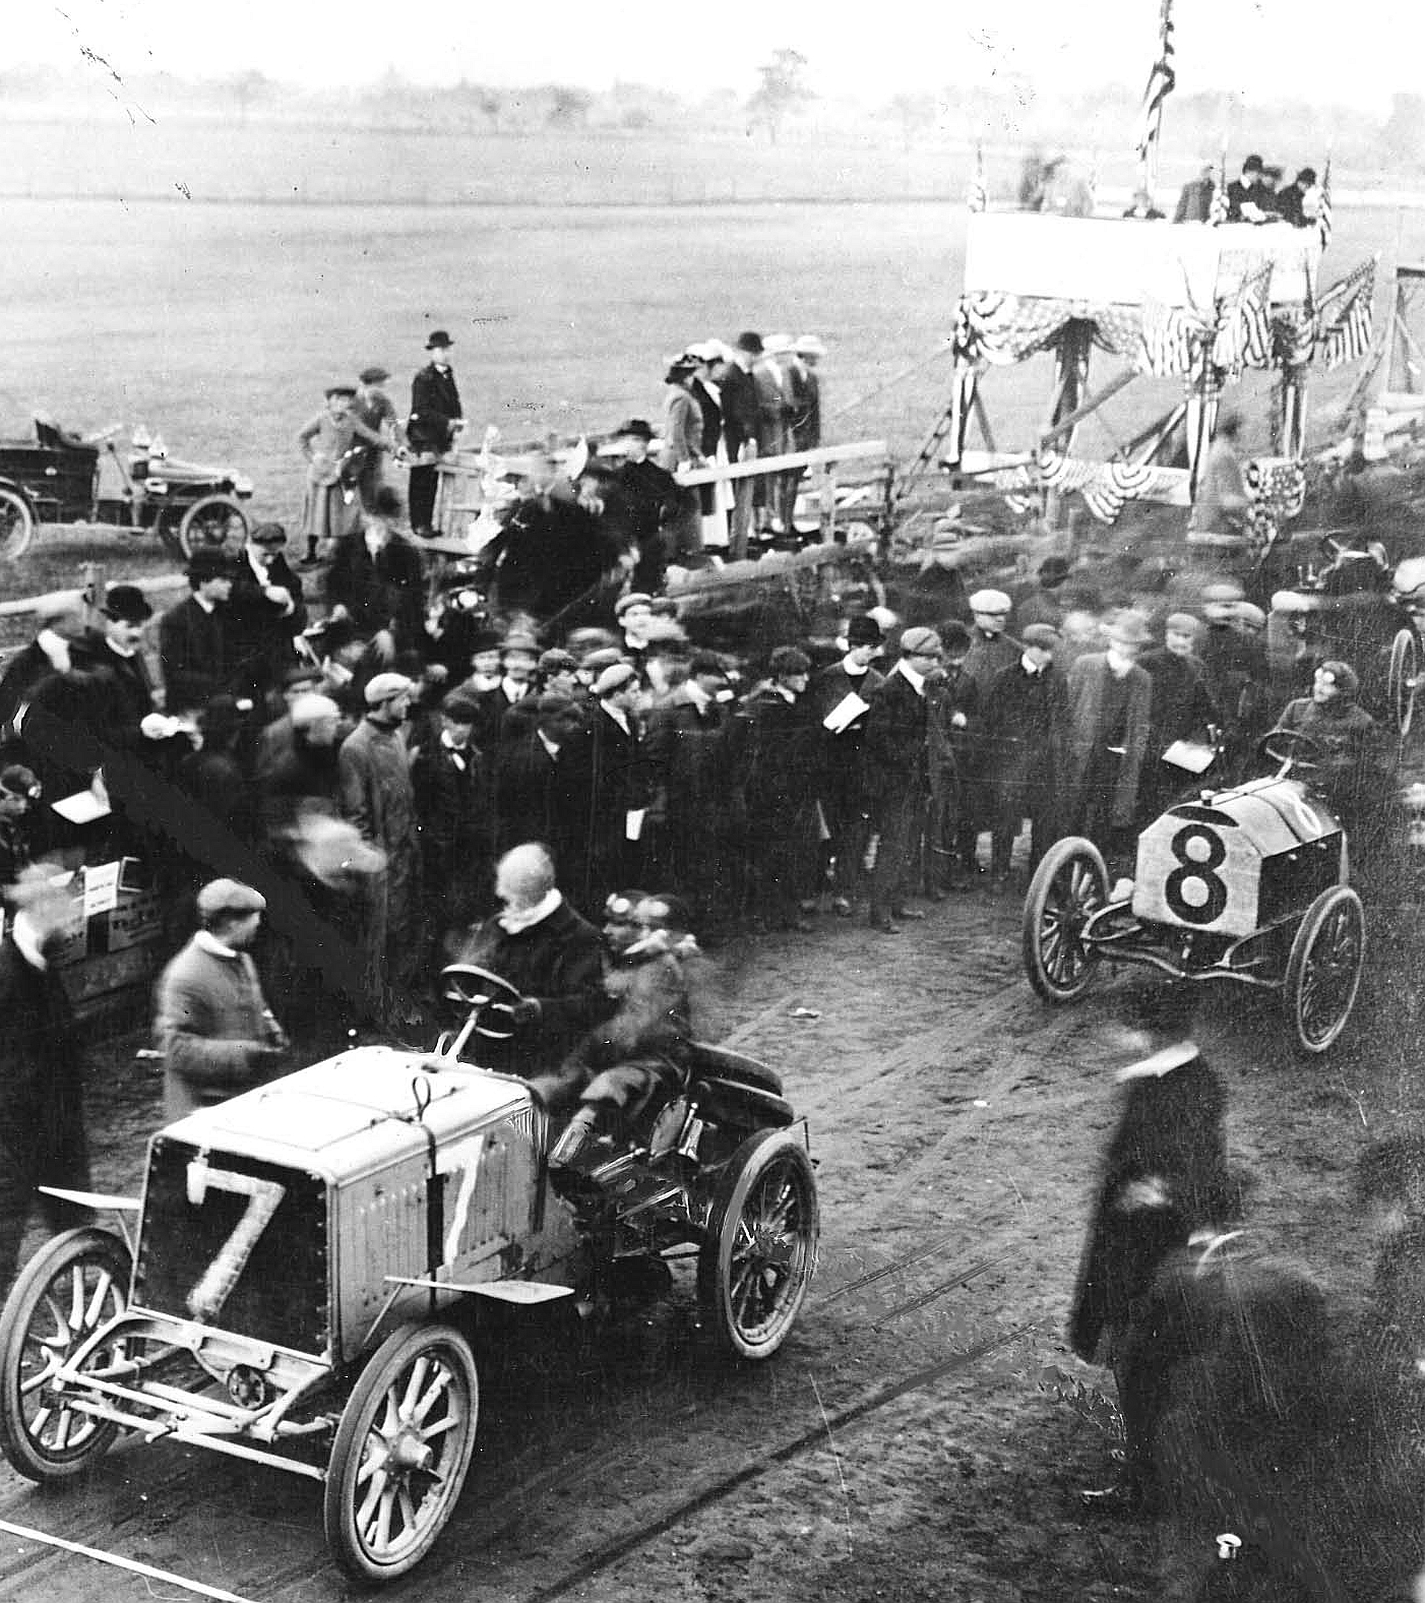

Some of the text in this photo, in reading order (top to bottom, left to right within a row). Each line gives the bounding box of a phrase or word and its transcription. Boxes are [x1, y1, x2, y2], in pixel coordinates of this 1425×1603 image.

[1165, 823, 1228, 925] 8
[186, 1161, 286, 1315] 7
[435, 1133, 485, 1267] 7
